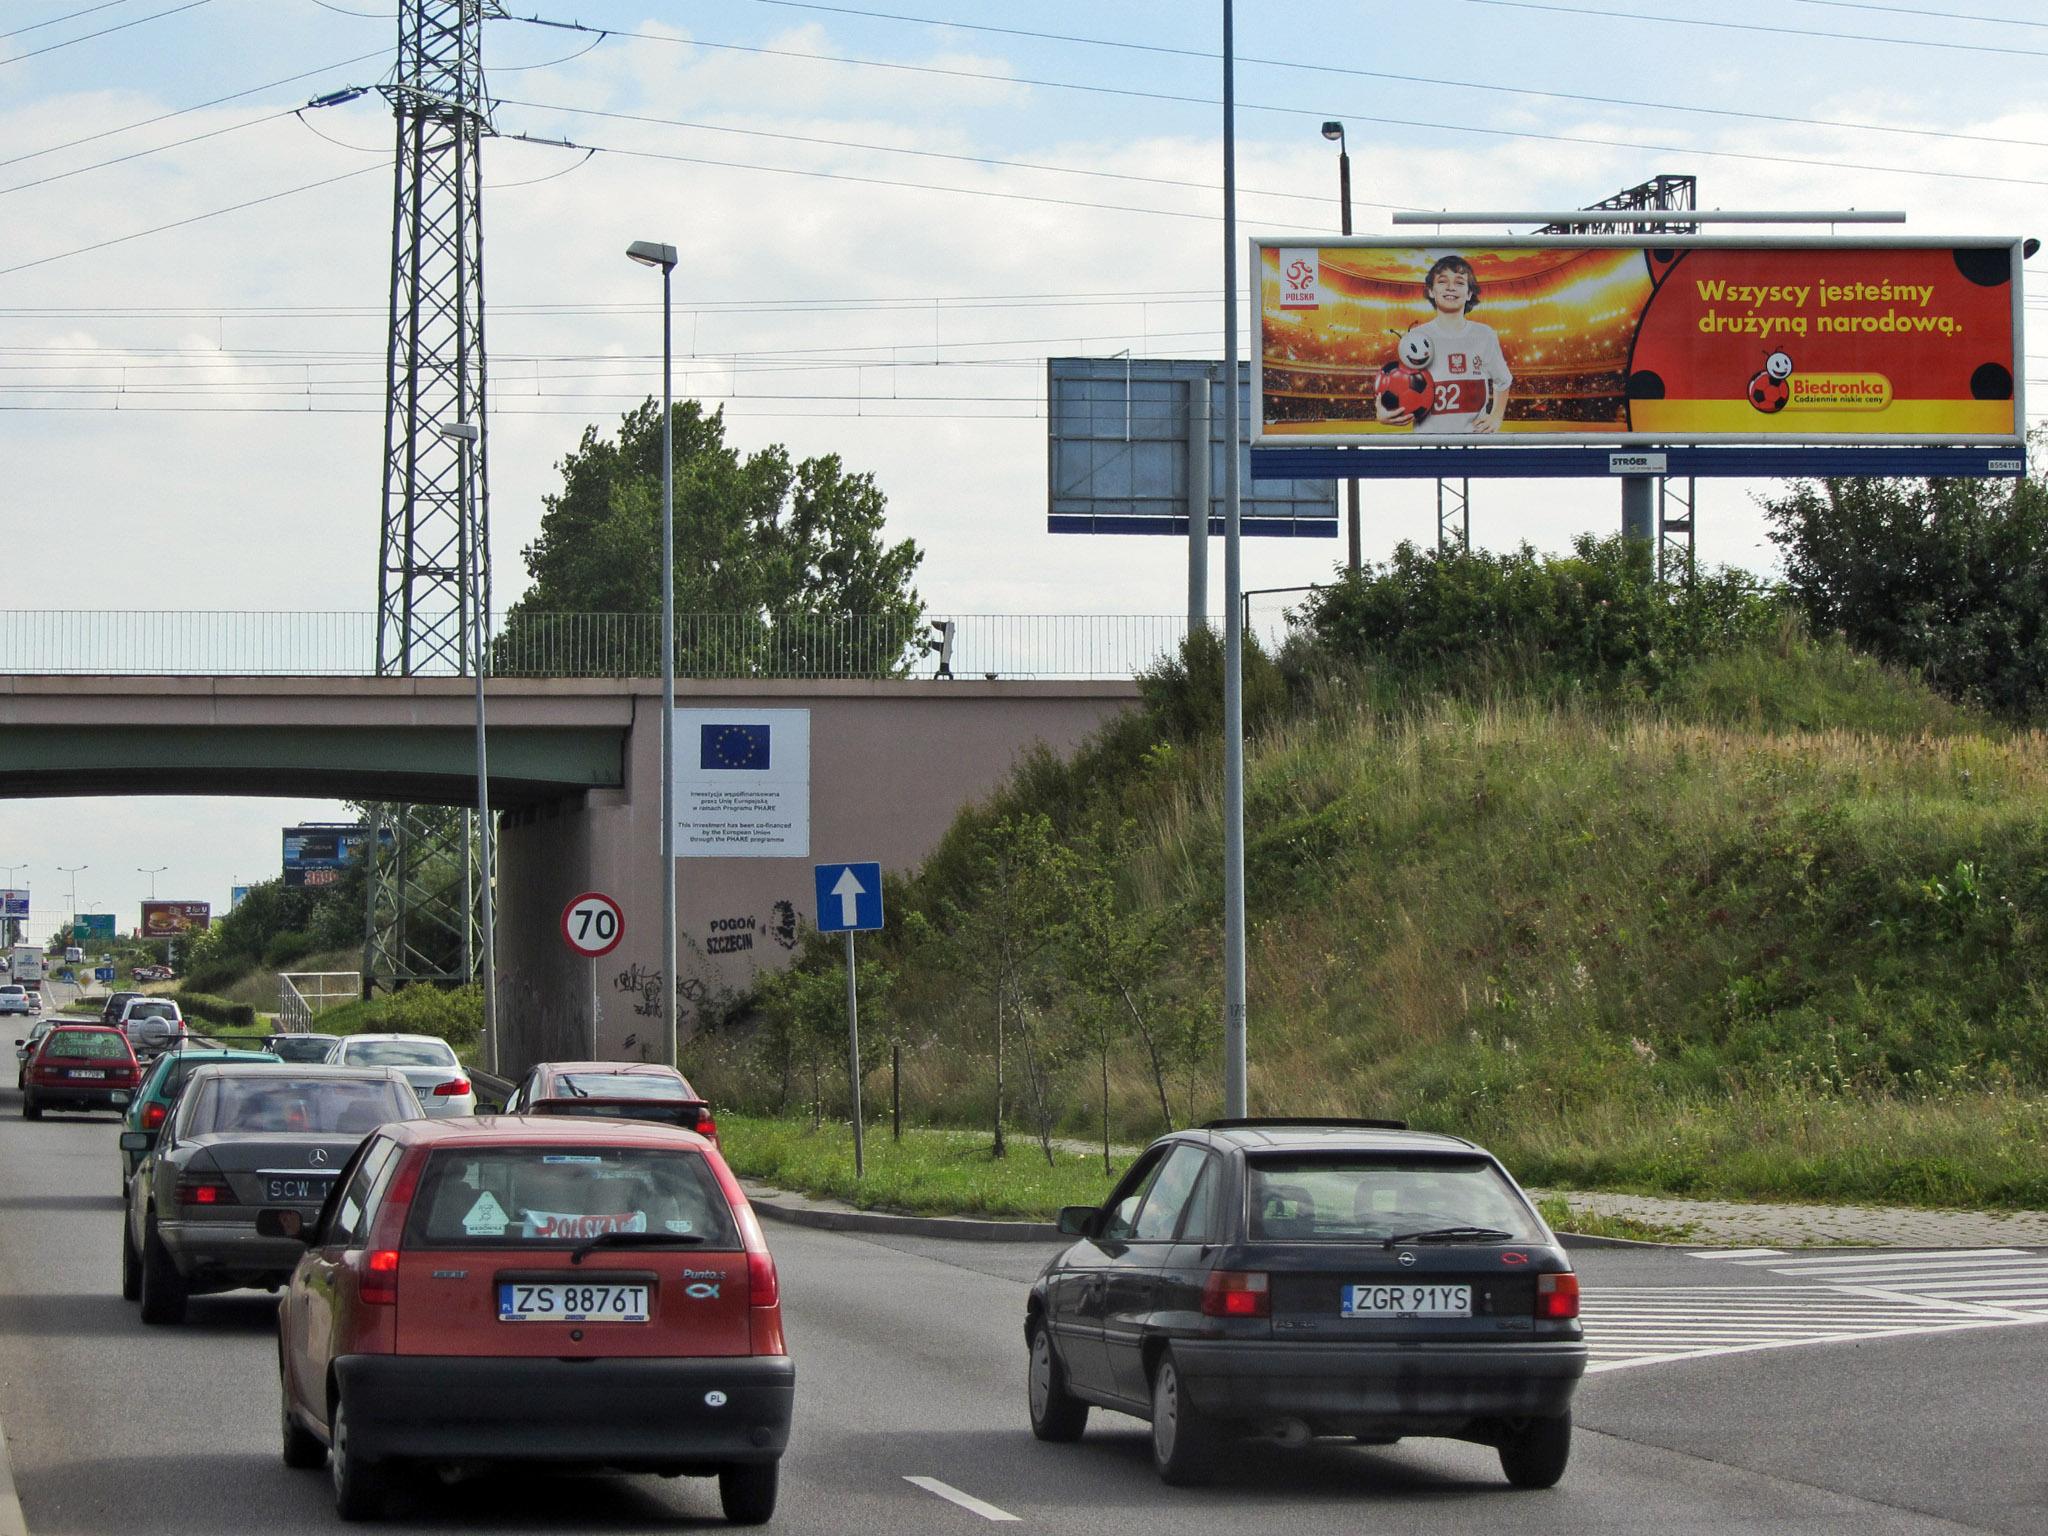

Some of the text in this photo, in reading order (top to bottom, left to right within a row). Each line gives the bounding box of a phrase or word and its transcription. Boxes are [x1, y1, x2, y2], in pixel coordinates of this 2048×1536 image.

[1285, 292, 1315, 301] POLSKA
[1697, 279, 1935, 308] Wszyscy jesteśmy
[1698, 309, 1963, 338] drużyną narodową.
[1793, 379, 1884, 395] Biedronka
[1434, 384, 1460, 411] 32
[1794, 395, 1838, 403] Codziennie
[690, 836, 714, 844] through
[722, 829, 752, 837] European
[575, 910, 616, 940] 70
[710, 914, 756, 932] POGOŃ
[707, 933, 753, 955] SZCZECIN
[271, 1180, 309, 1197] SCW
[683, 1268, 717, 1280] Punto
[502, 1303, 511, 1311] PL
[517, 1287, 644, 1313] ZS 8876T
[1357, 1287, 1468, 1310] ZGR 91YS
[710, 1394, 722, 1403] PL
